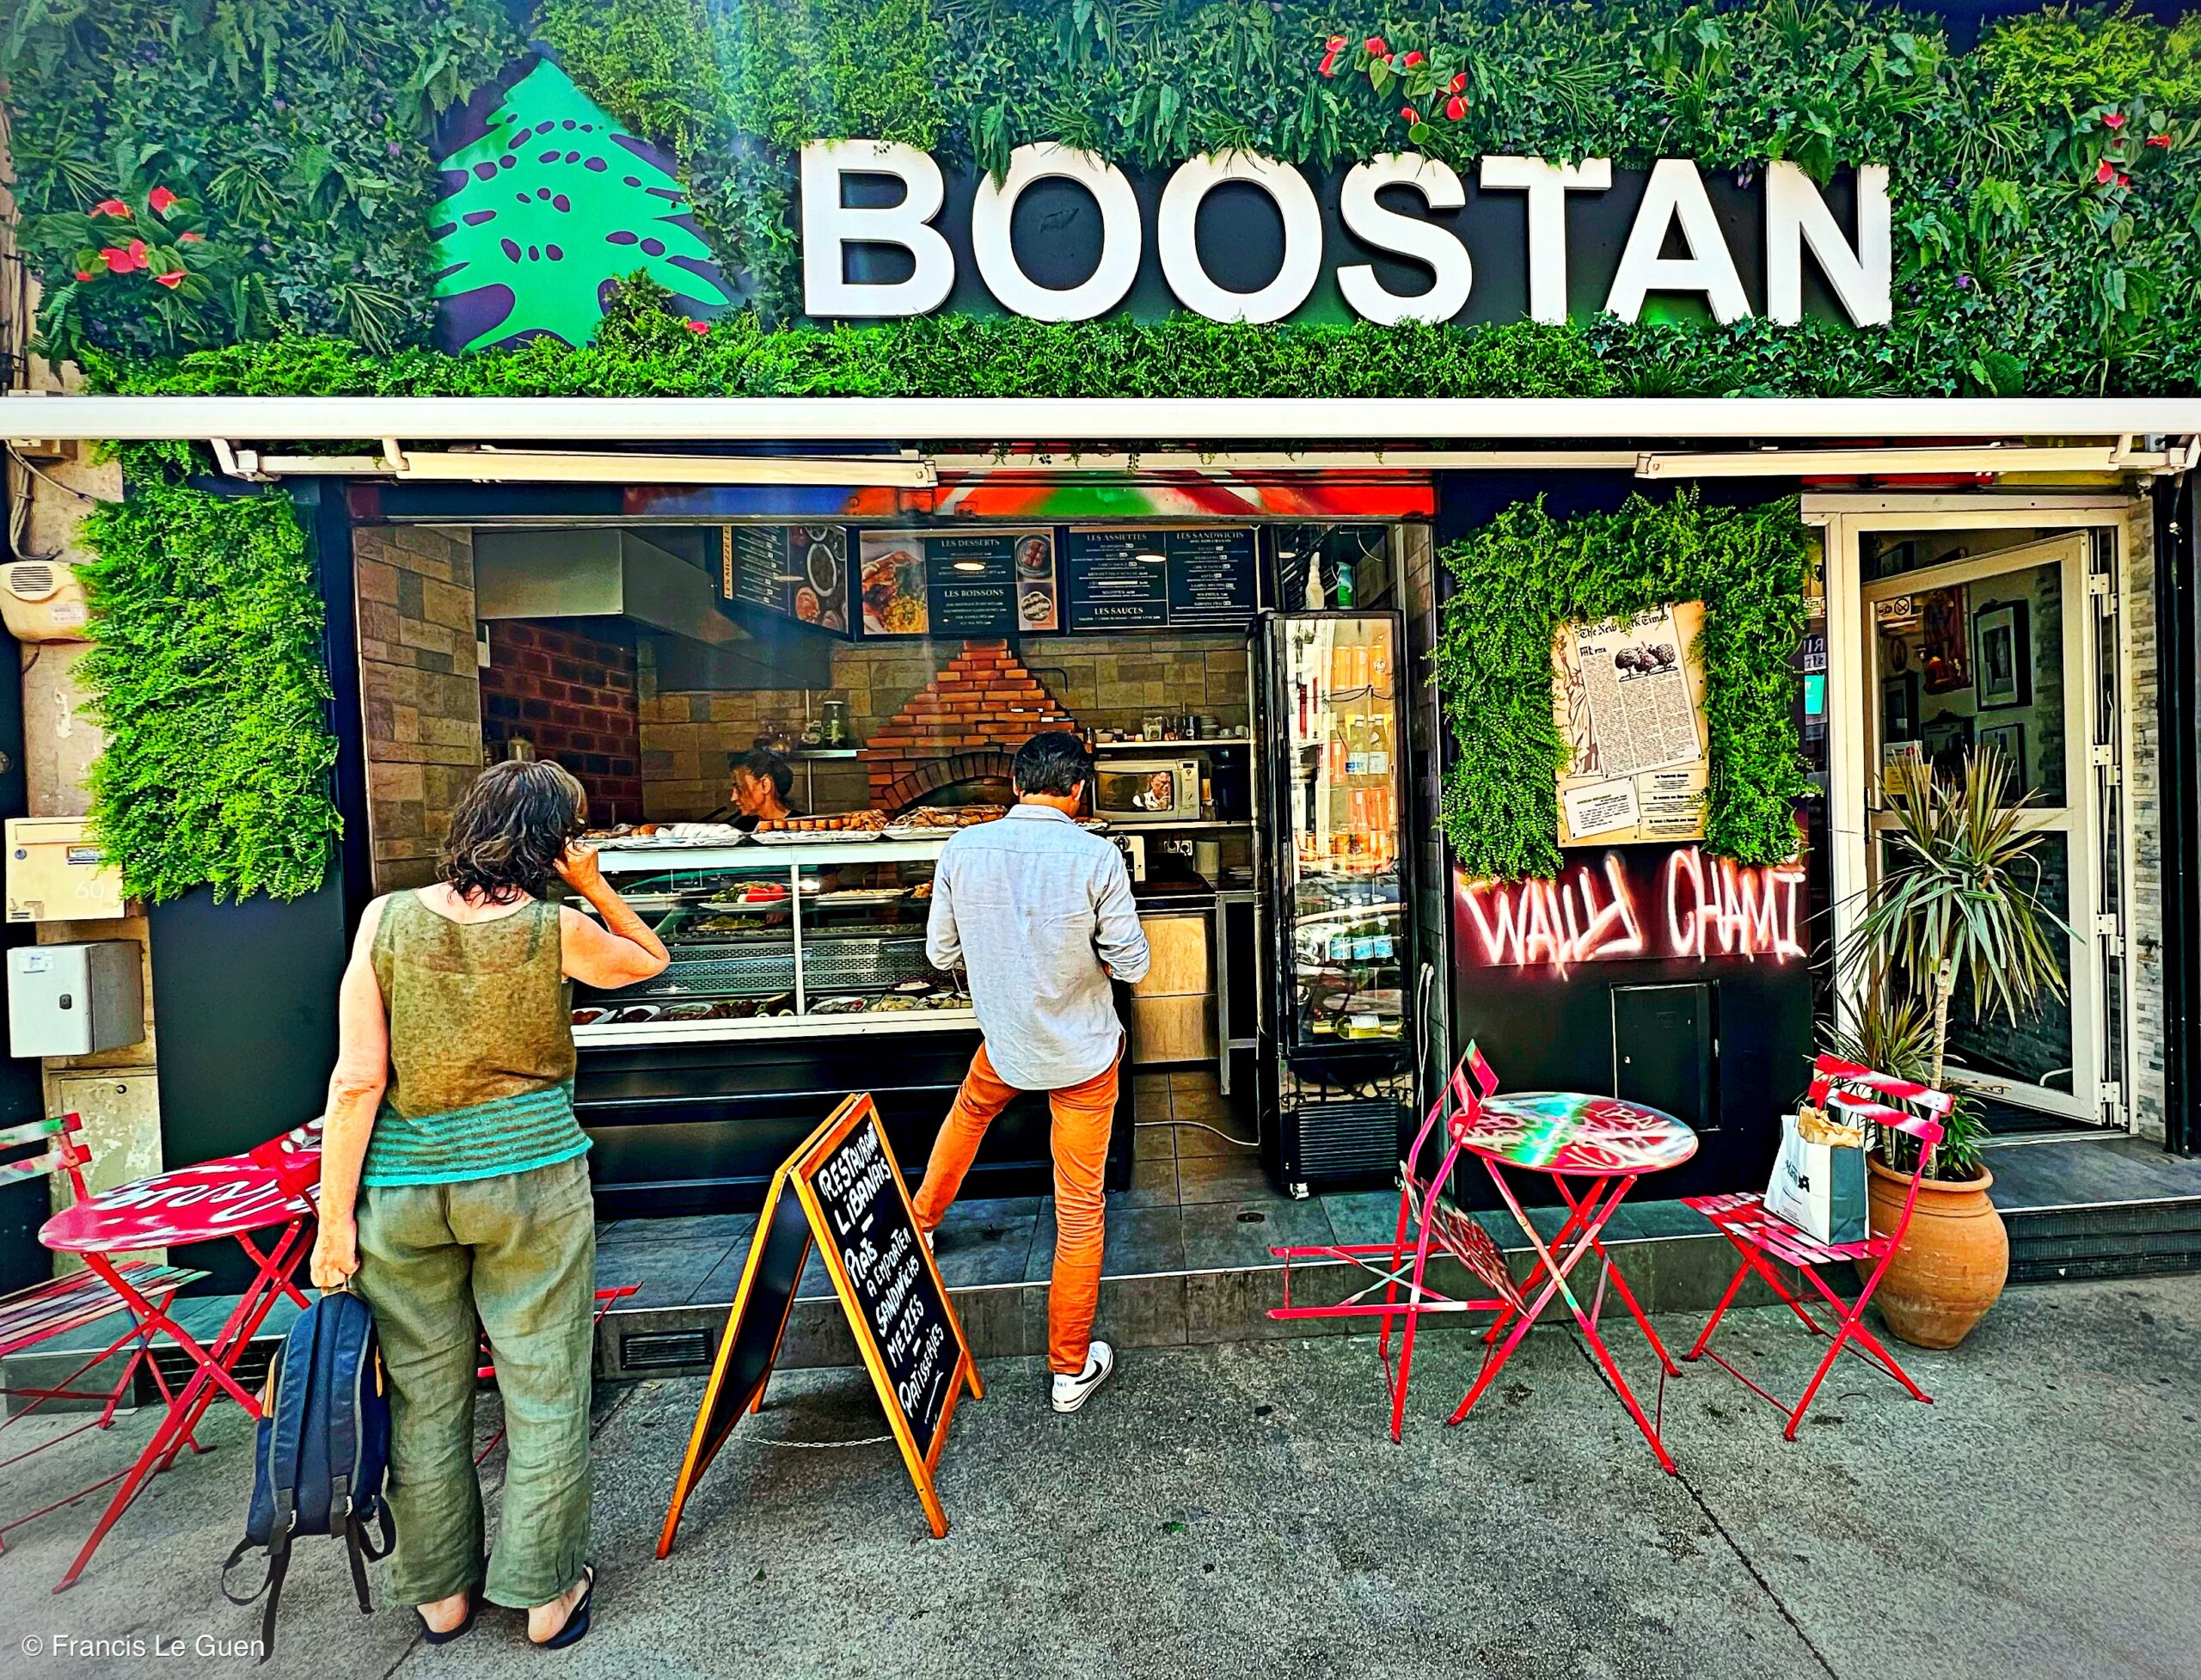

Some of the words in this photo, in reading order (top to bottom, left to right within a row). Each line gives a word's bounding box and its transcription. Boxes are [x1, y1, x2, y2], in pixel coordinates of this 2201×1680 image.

[800, 138, 1893, 328] BOOSTAN
[1111, 606, 1143, 615] SAUCES
[1579, 627, 1597, 639] The
[1597, 623, 1617, 635] New
[75, 880, 105, 899] 60
[818, 1120, 879, 1202] RESTAURANT
[867, 1278, 875, 1297] A
[875, 1226, 911, 1285] EMPORTER
[886, 1293, 924, 1368] MEZZES
[898, 1322, 945, 1419] PATISSERIES
